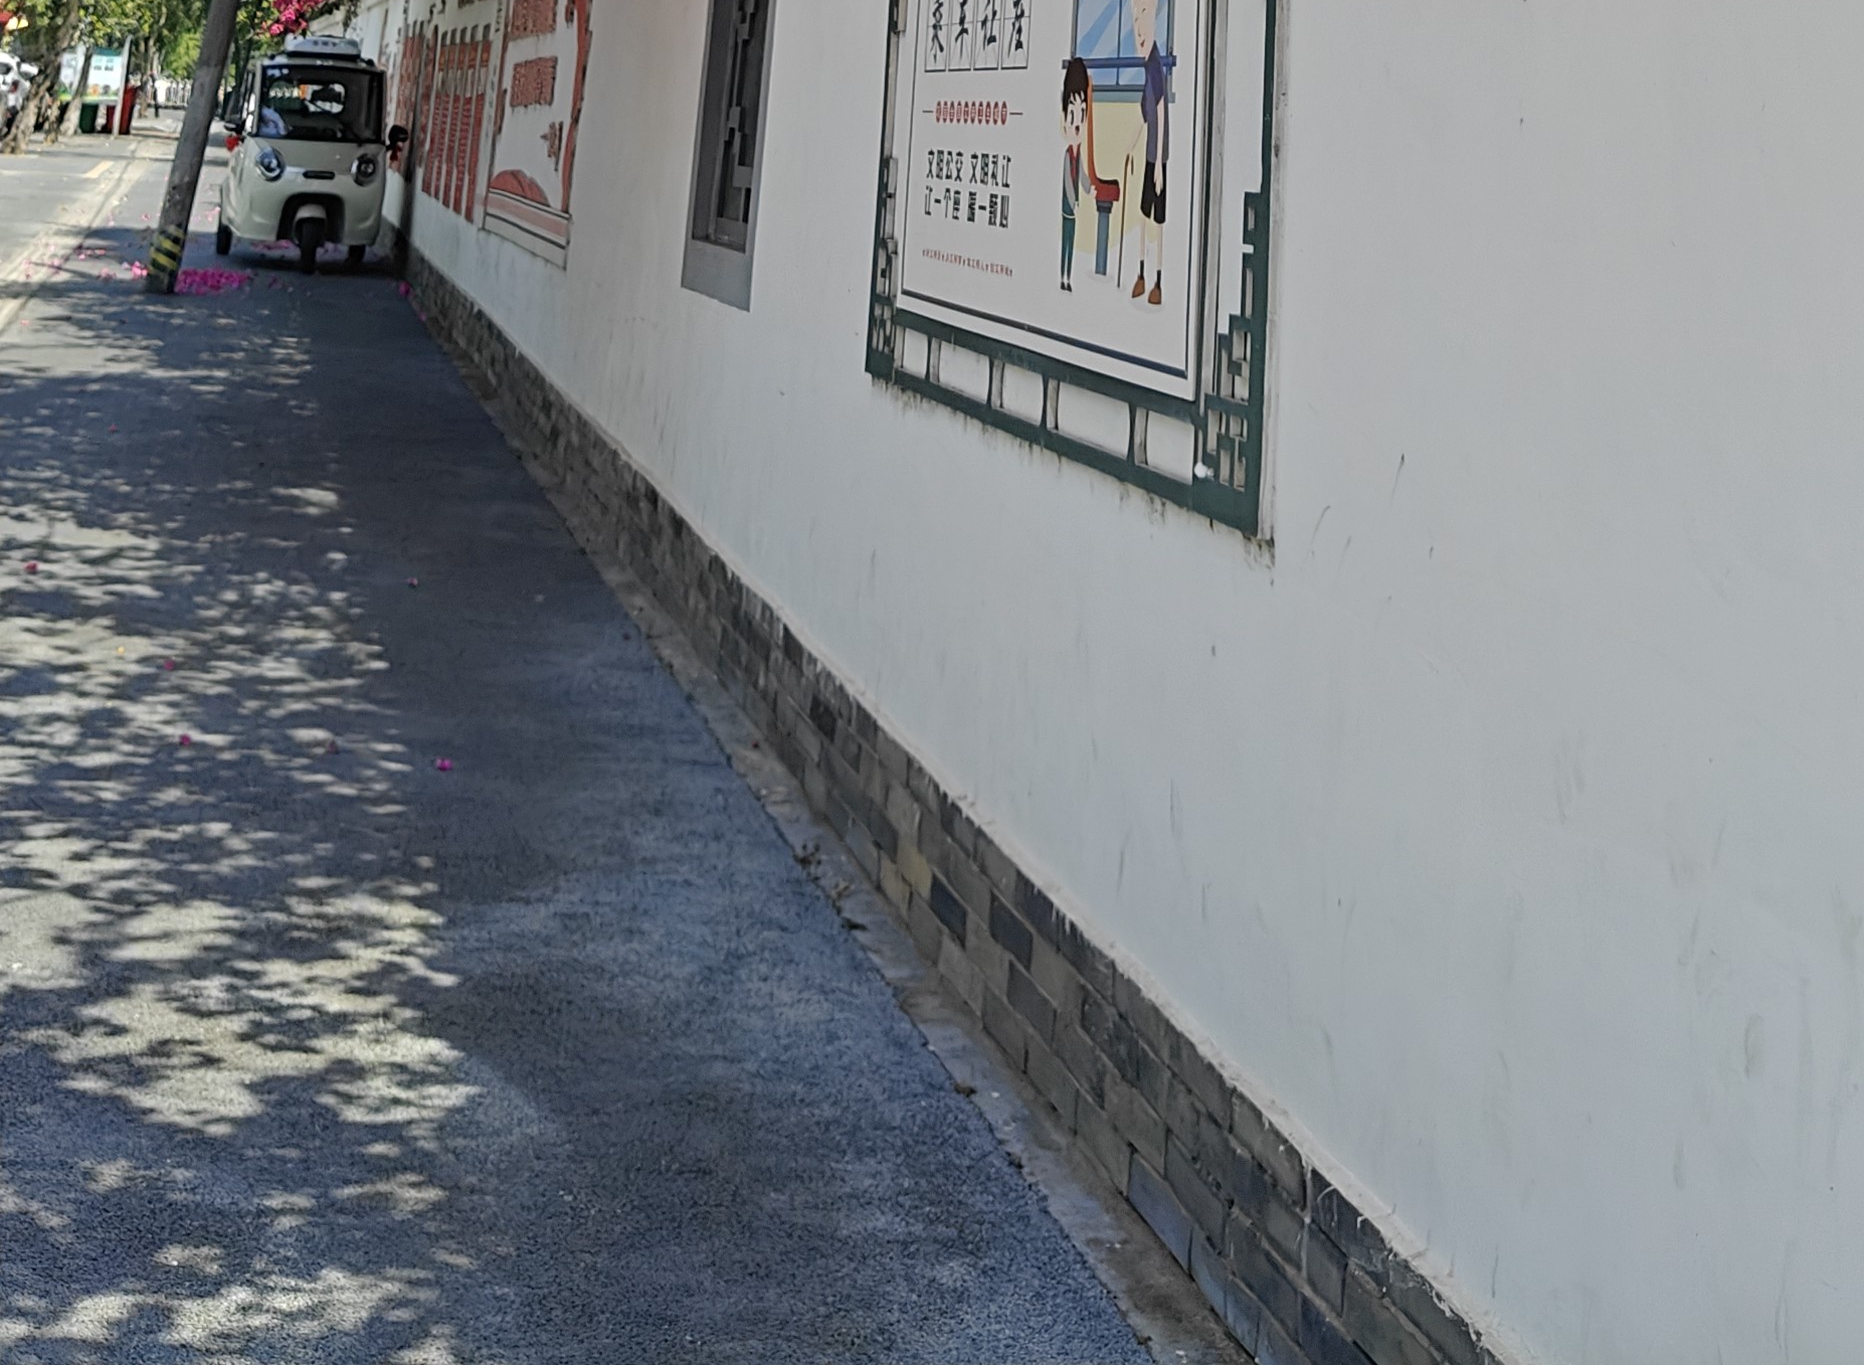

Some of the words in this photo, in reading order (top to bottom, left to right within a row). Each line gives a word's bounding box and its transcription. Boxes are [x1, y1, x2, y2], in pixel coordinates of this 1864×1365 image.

[926, 148, 964, 183] 文明公交
[969, 152, 1011, 188] 文明礼让
[924, 185, 961, 220] 让一个座
[967, 190, 1009, 228] 暖一颗心
